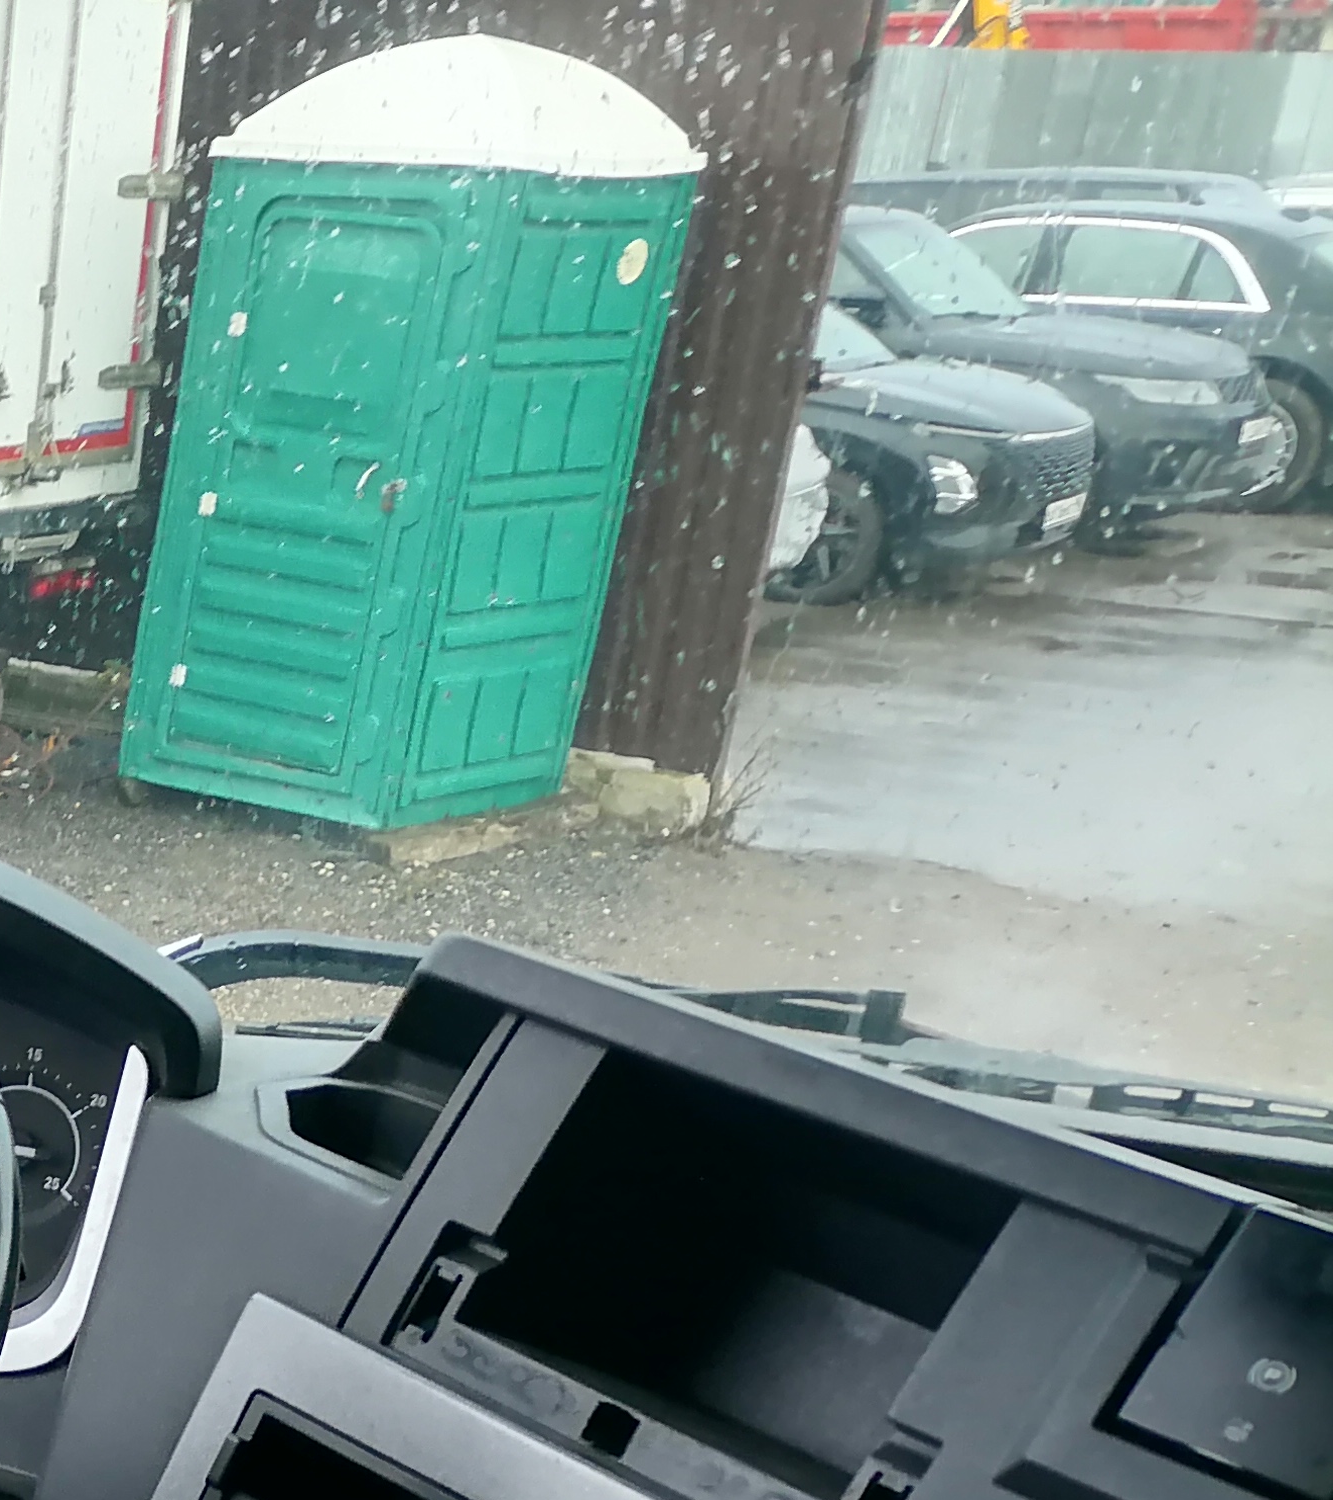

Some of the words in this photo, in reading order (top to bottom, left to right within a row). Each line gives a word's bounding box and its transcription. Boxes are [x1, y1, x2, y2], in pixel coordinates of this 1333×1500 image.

[26, 1047, 43, 1062] 15
[90, 1093, 108, 1108] 20
[43, 1175, 60, 1190] 25
